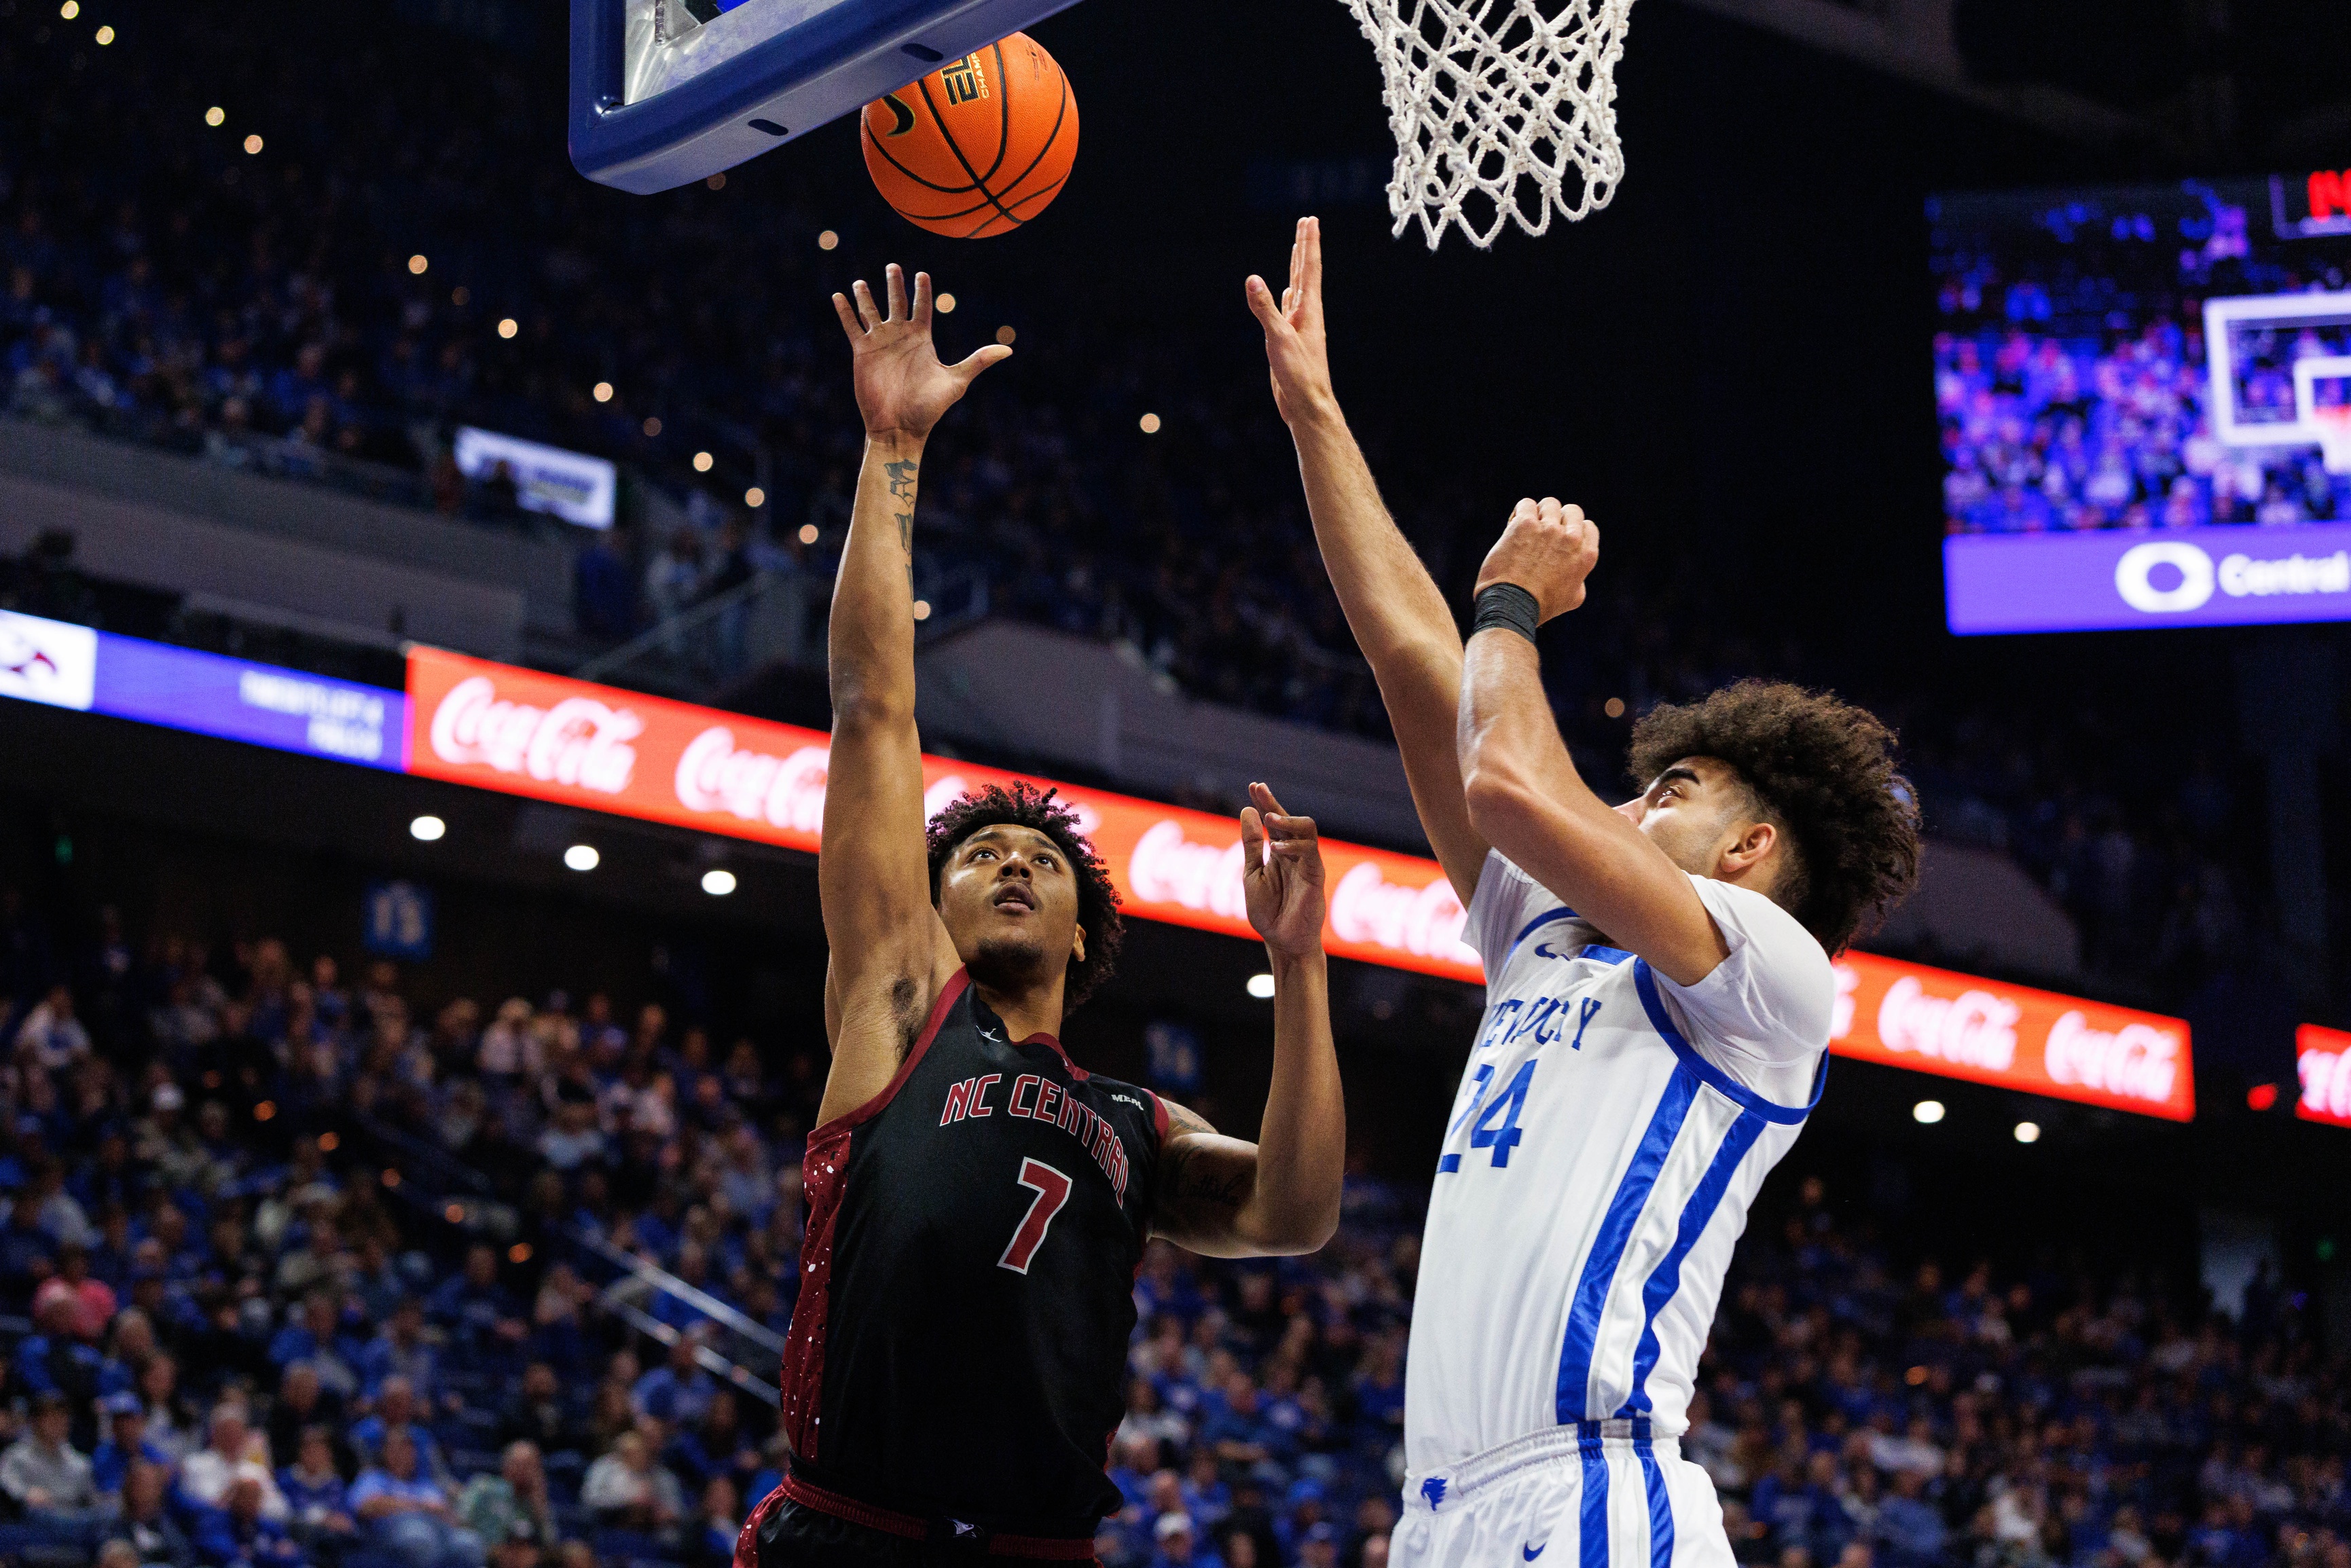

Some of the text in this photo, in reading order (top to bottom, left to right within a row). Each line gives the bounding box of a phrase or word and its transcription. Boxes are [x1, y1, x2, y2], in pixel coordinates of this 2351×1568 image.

[939, 1073, 1002, 1127] NC
[1437, 1058, 1537, 1174] 24
[996, 1156, 1073, 1275] 7
